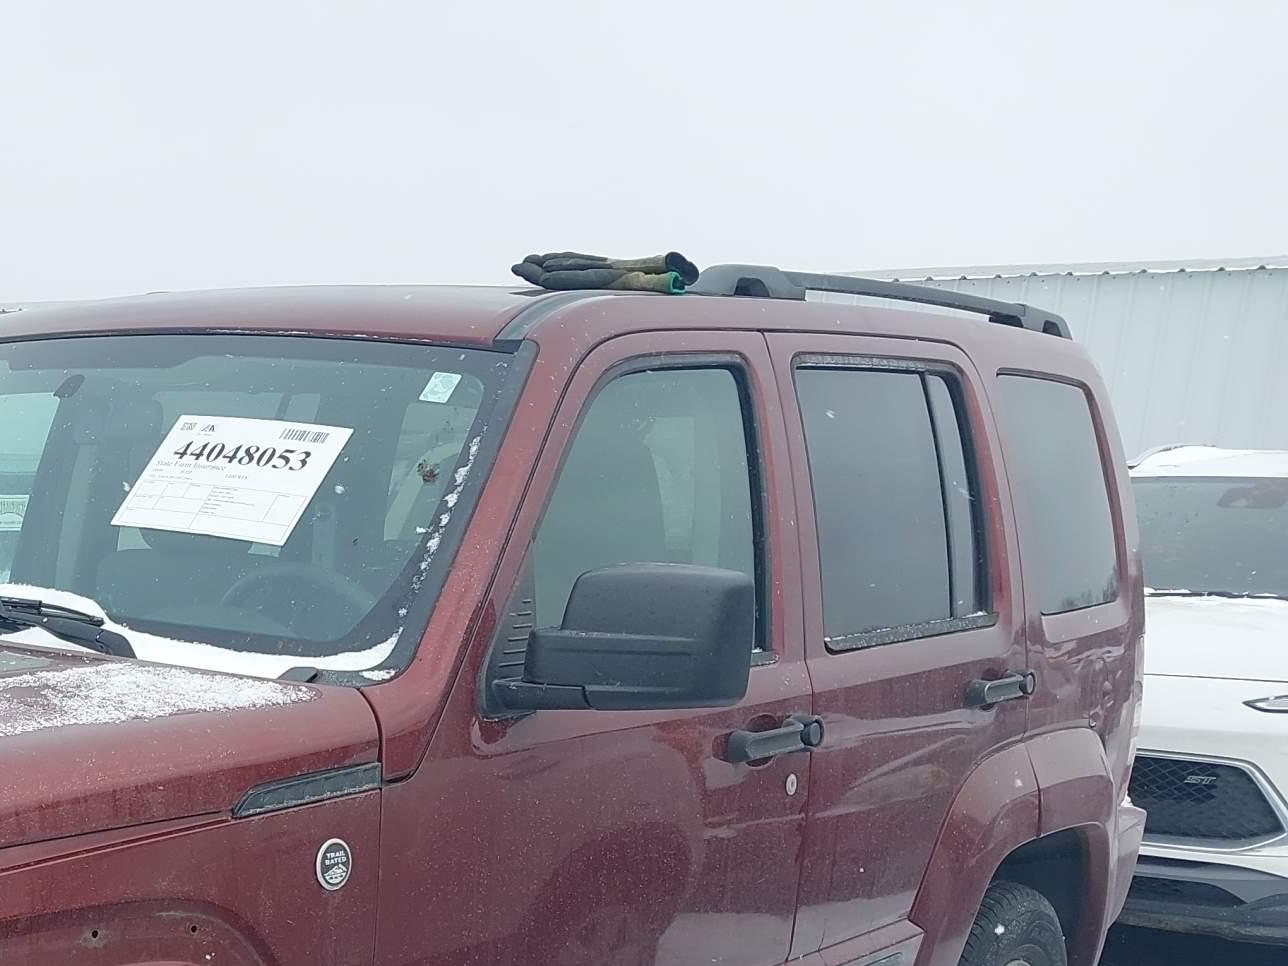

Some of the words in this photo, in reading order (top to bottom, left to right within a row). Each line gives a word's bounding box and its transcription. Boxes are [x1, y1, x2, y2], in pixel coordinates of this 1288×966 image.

[173, 440, 312, 471] 44048053
[1183, 775, 1217, 784] ST
[325, 857, 346, 865] RATED
